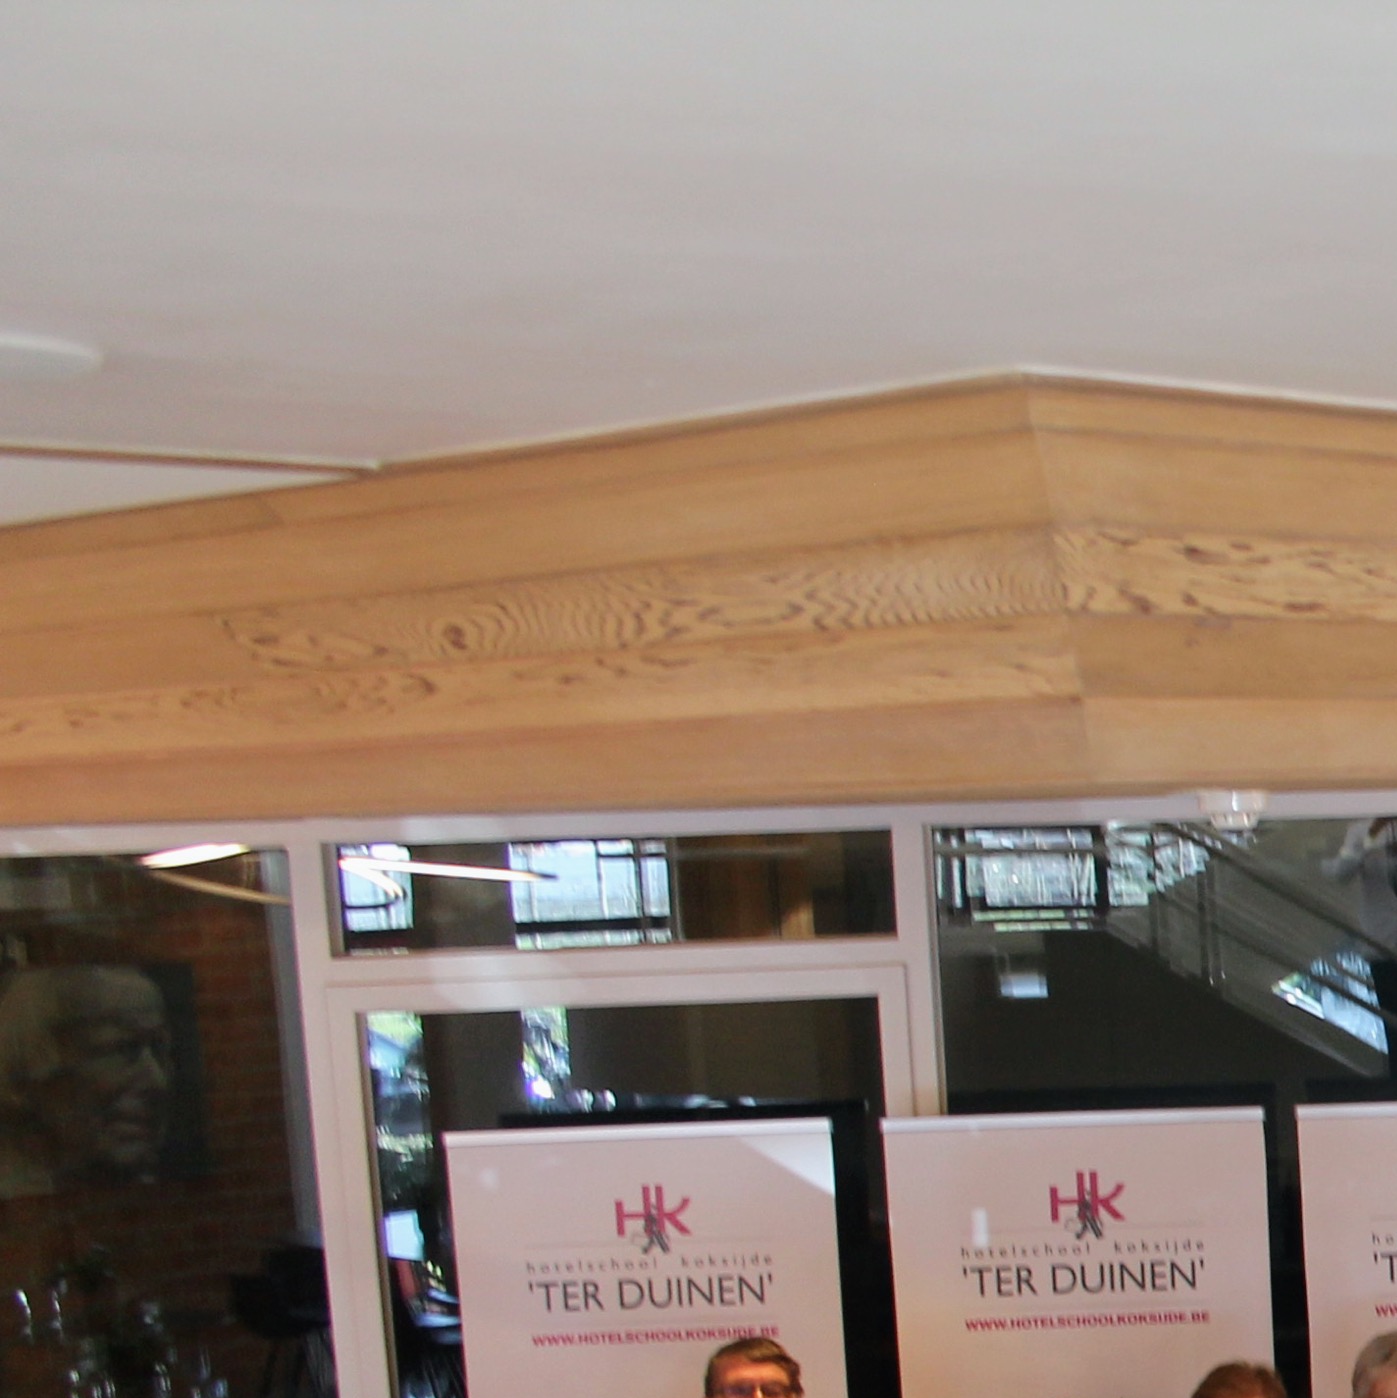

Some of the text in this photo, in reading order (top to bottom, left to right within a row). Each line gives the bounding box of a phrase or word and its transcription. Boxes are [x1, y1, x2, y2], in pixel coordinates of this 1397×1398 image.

[961, 1239, 1205, 1259] hotelschool koksijde
[526, 1253, 773, 1274] hotelschool koksijde
